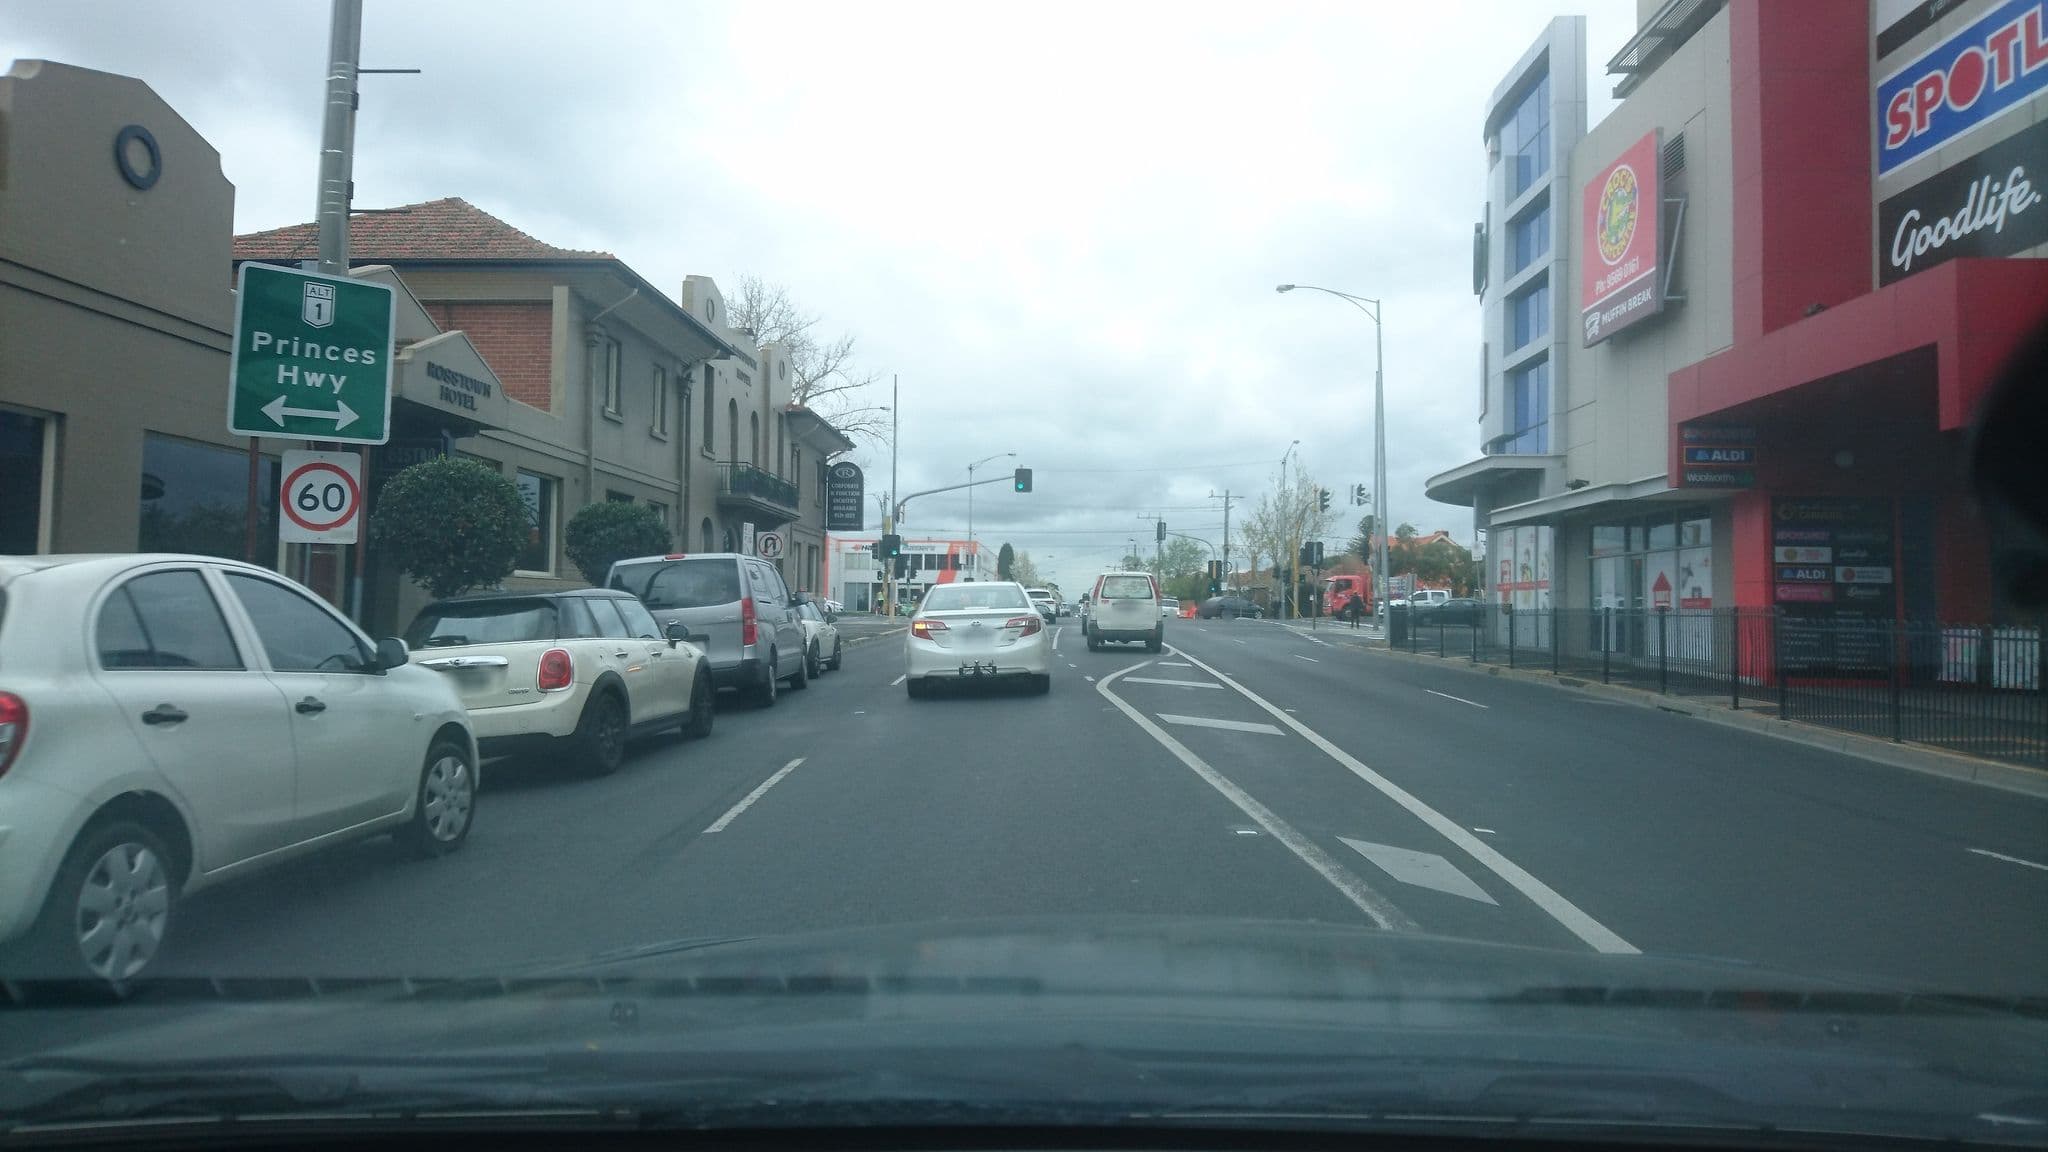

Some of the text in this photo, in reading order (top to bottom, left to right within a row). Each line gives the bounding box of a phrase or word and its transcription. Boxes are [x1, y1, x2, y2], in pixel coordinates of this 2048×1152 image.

[309, 286, 330, 297] ALT
[1602, 302, 1628, 326] MUFFIN
[1628, 286, 1652, 311] BREAK
[315, 302, 322, 320] 1
[251, 330, 377, 366] Princes
[276, 363, 347, 394] Hwy
[426, 360, 492, 398] ROSSTOWN
[439, 383, 479, 412] HOTEL
[1711, 450, 1745, 461] ALDI
[297, 483, 346, 512] 60
[1796, 568, 1826, 580] ALDI
